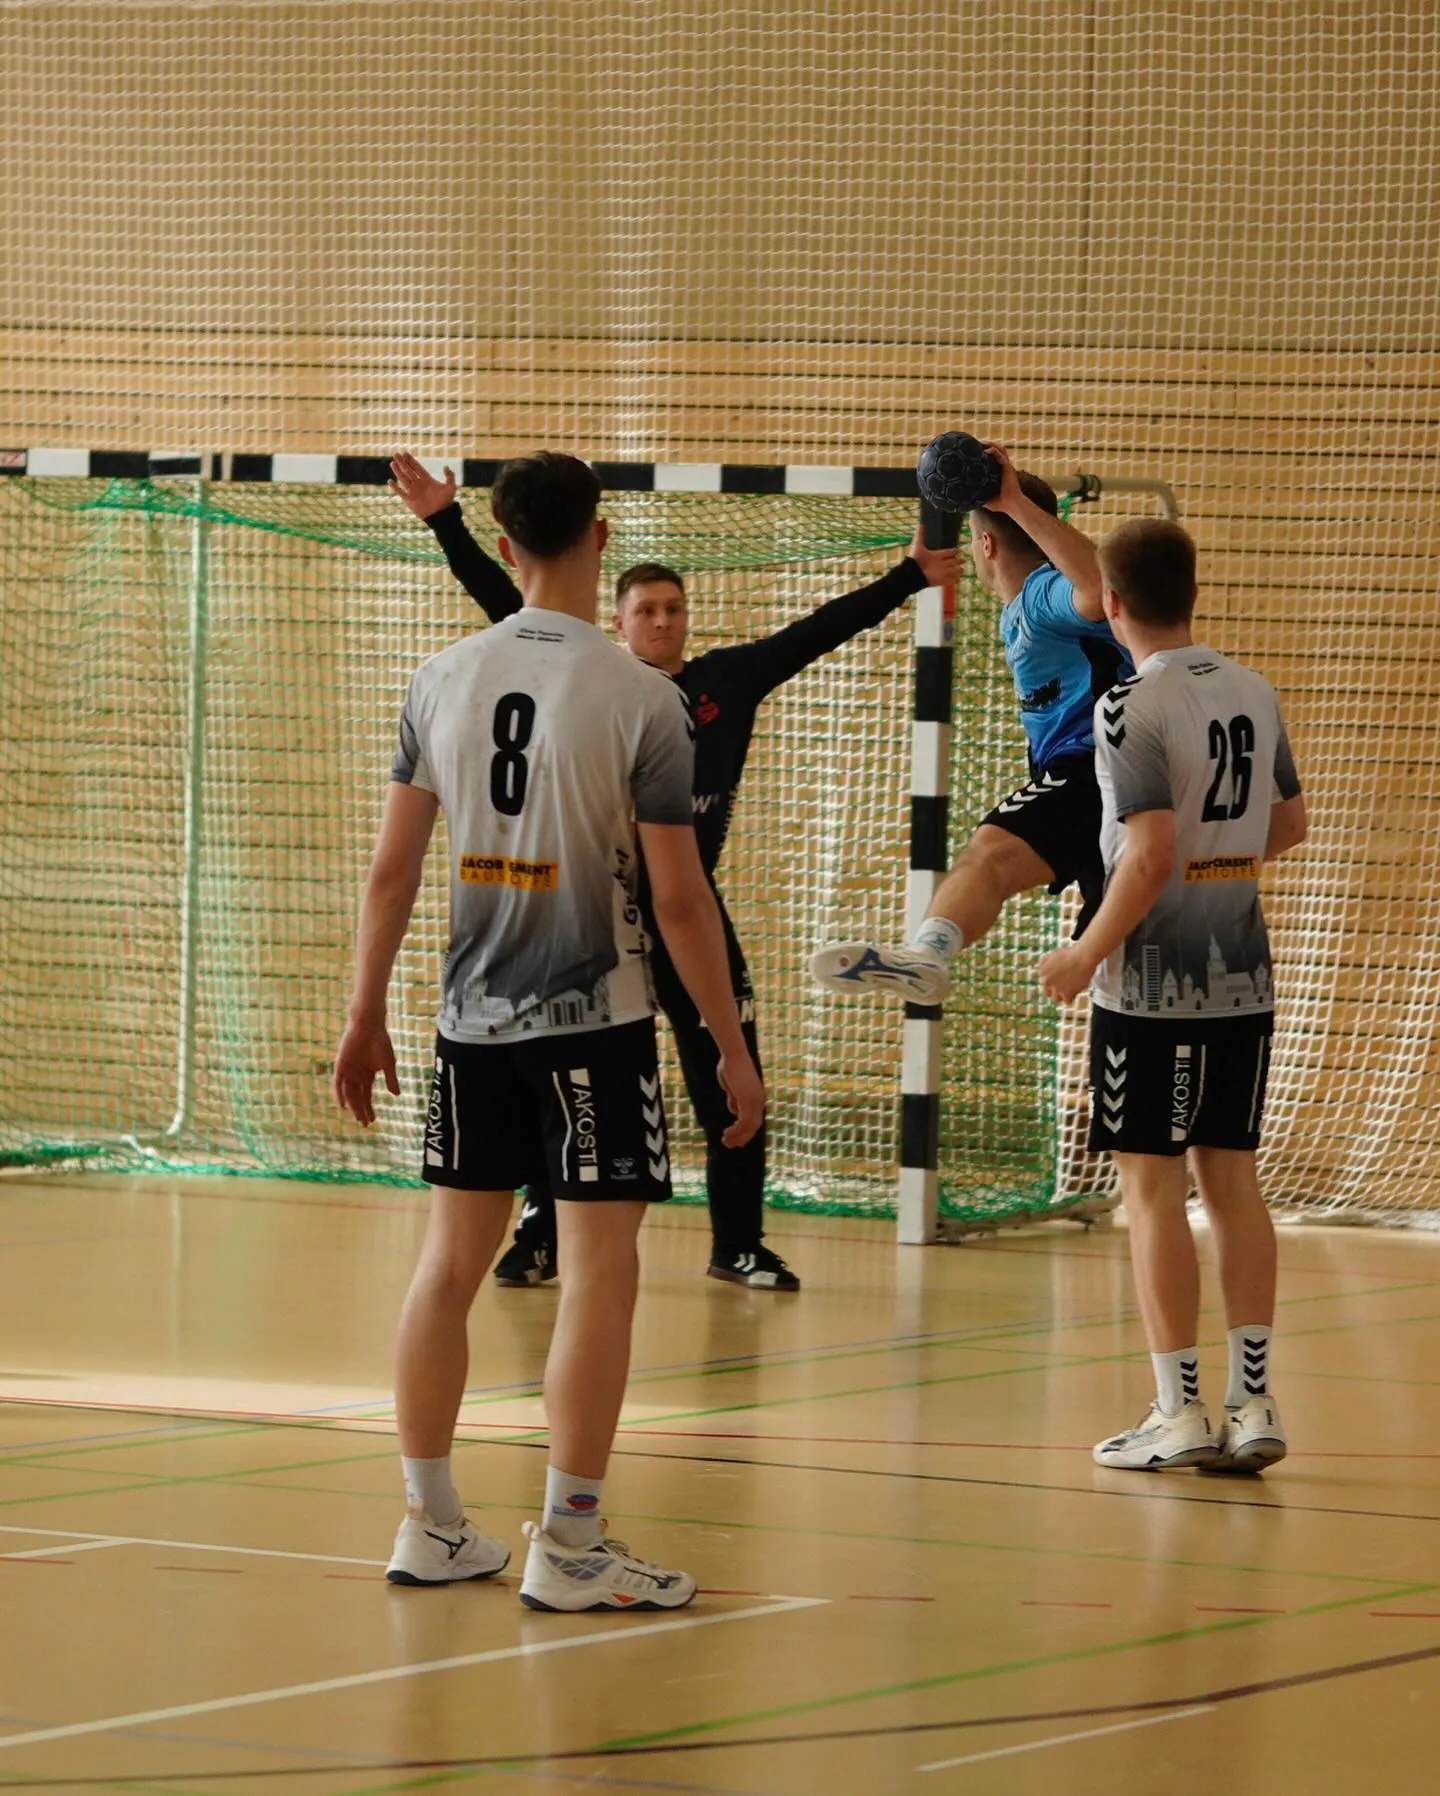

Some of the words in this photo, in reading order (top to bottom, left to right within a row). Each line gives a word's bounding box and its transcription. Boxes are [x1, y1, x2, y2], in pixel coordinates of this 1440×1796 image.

[490, 692, 536, 816] 8
[1201, 714, 1255, 822] 26
[460, 869, 553, 887] BAUSOFFE
[461, 858, 504, 870] JACOB
[509, 862, 551, 876] EMENT
[572, 1087, 598, 1165] AKOSTI
[1171, 1059, 1191, 1126] AKOSTI
